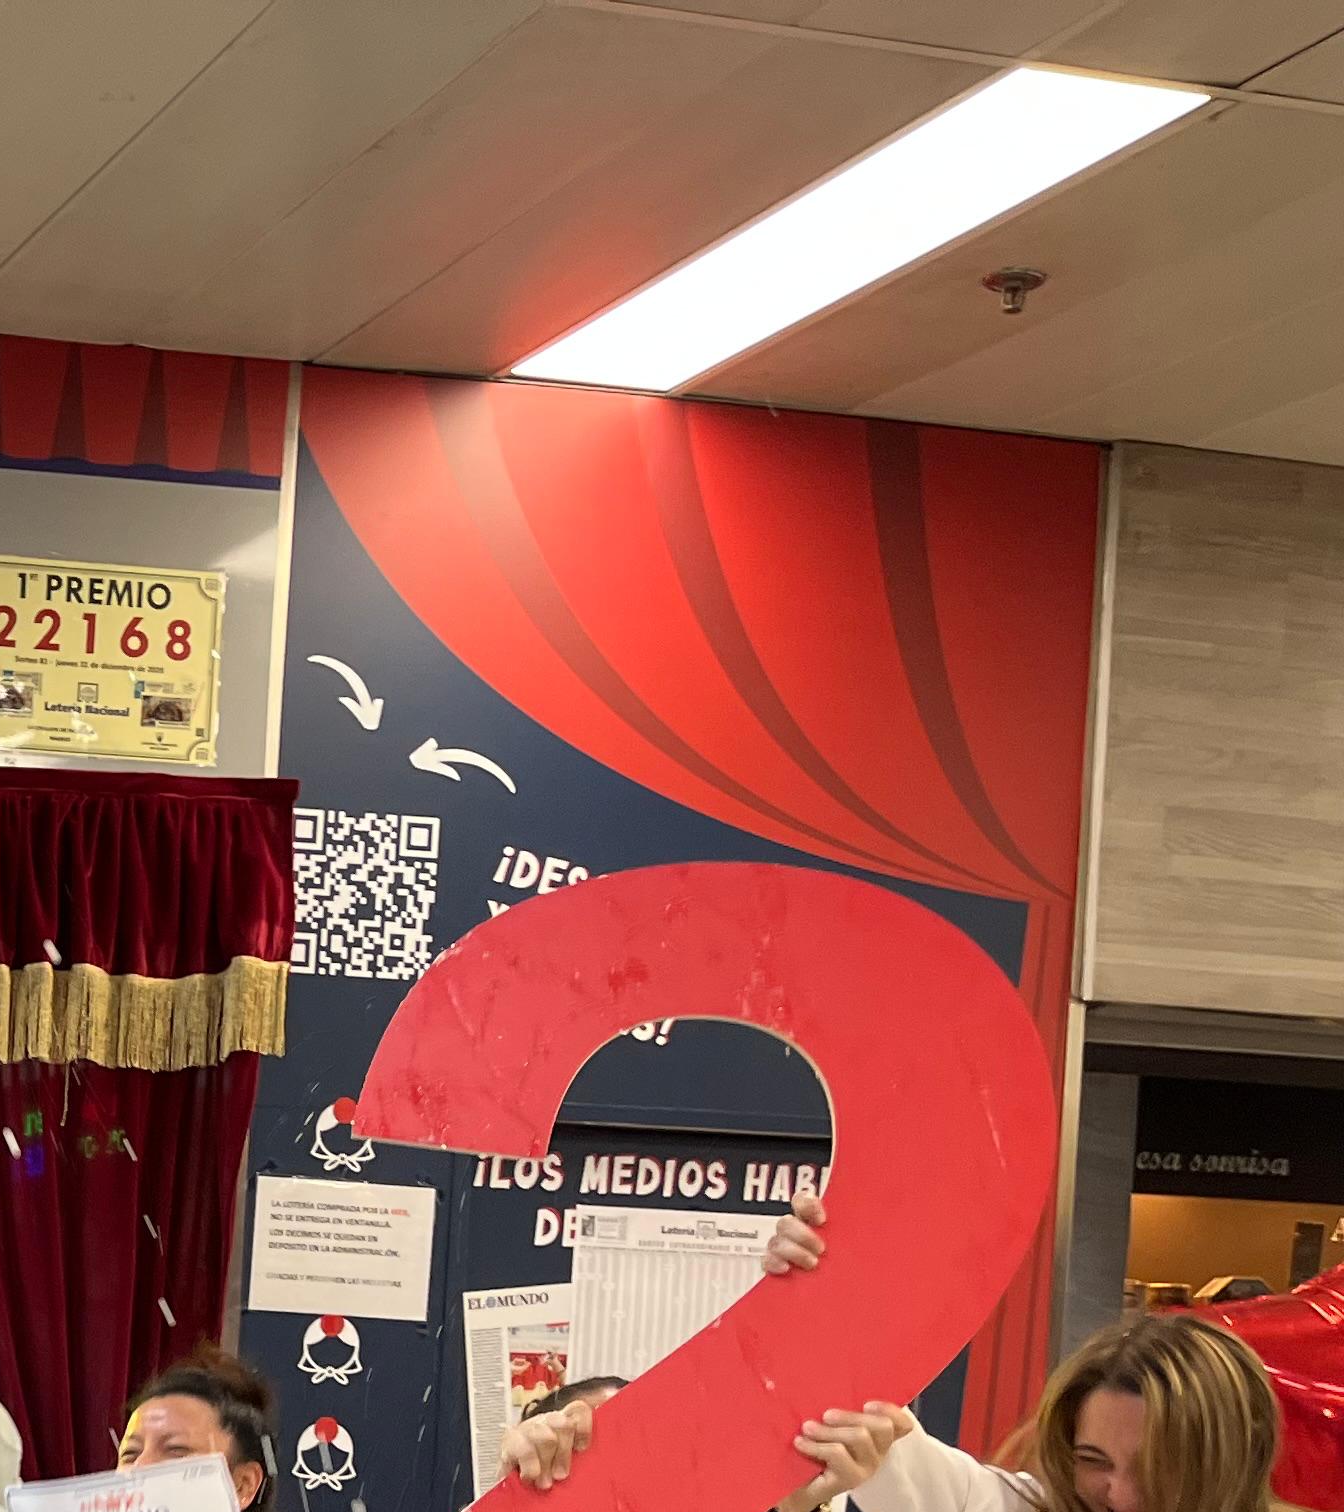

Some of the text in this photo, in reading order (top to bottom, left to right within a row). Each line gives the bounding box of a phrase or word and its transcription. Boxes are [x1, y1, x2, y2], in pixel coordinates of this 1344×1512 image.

[45, 574, 172, 610] PREMIO
[473, 1152, 564, 1193] ¡LOS
[579, 1154, 729, 1201] MEDIOS
[468, 1292, 550, 1311] EL MUNDO
